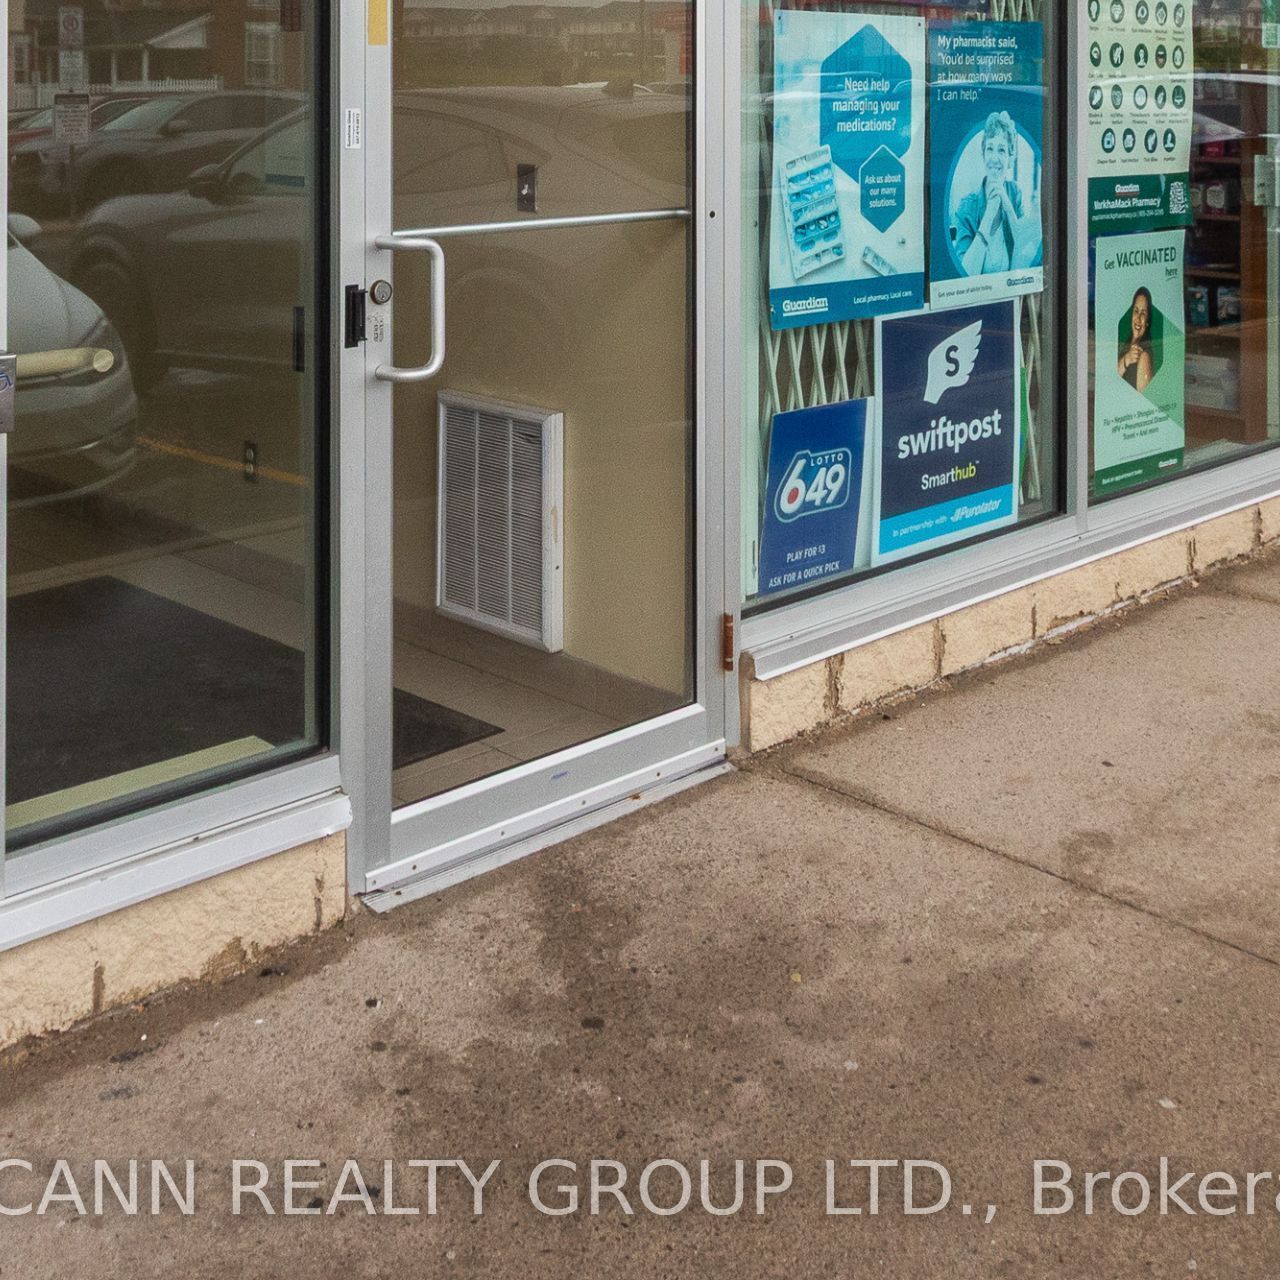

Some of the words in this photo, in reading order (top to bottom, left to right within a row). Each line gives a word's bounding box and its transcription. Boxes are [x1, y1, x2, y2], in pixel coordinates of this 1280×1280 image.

[937, 35, 951, 50] My
[953, 35, 996, 50] pharmacist
[998, 36, 1018, 49] said,
[965, 53, 974, 65] be
[976, 52, 1014, 67] surprised
[844, 77, 869, 92] Need
[870, 78, 890, 93] help
[937, 72, 946, 81] at
[948, 71, 966, 82] how
[967, 72, 990, 85] many
[990, 72, 1012, 85] ways
[942, 90, 958, 101] can
[832, 99, 879, 115] managing
[880, 101, 900, 112] your
[837, 118, 897, 132] medications?
[865, 175, 876, 185] Ask
[876, 175, 883, 184] us
[884, 174, 902, 184] about
[869, 187, 880, 196] our
[880, 187, 897, 197] many
[1104, 259, 1115, 270] Get
[1116, 246, 1177, 268] VACCINATED
[782, 296, 829, 313] Guardian
[854, 294, 866, 305] Local
[898, 409, 1002, 459] swiftpost
[810, 452, 844, 467] LOTTO
[780, 458, 846, 514] 649
[959, 498, 1002, 519] Purolator
[786, 551, 803, 563] PLAY
[804, 547, 818, 558] FOR
[768, 577, 782, 588] ASK
[783, 573, 797, 585] FOR
[797, 571, 803, 580] A
[803, 566, 824, 579] QUICK
[824, 560, 841, 573] PICK
